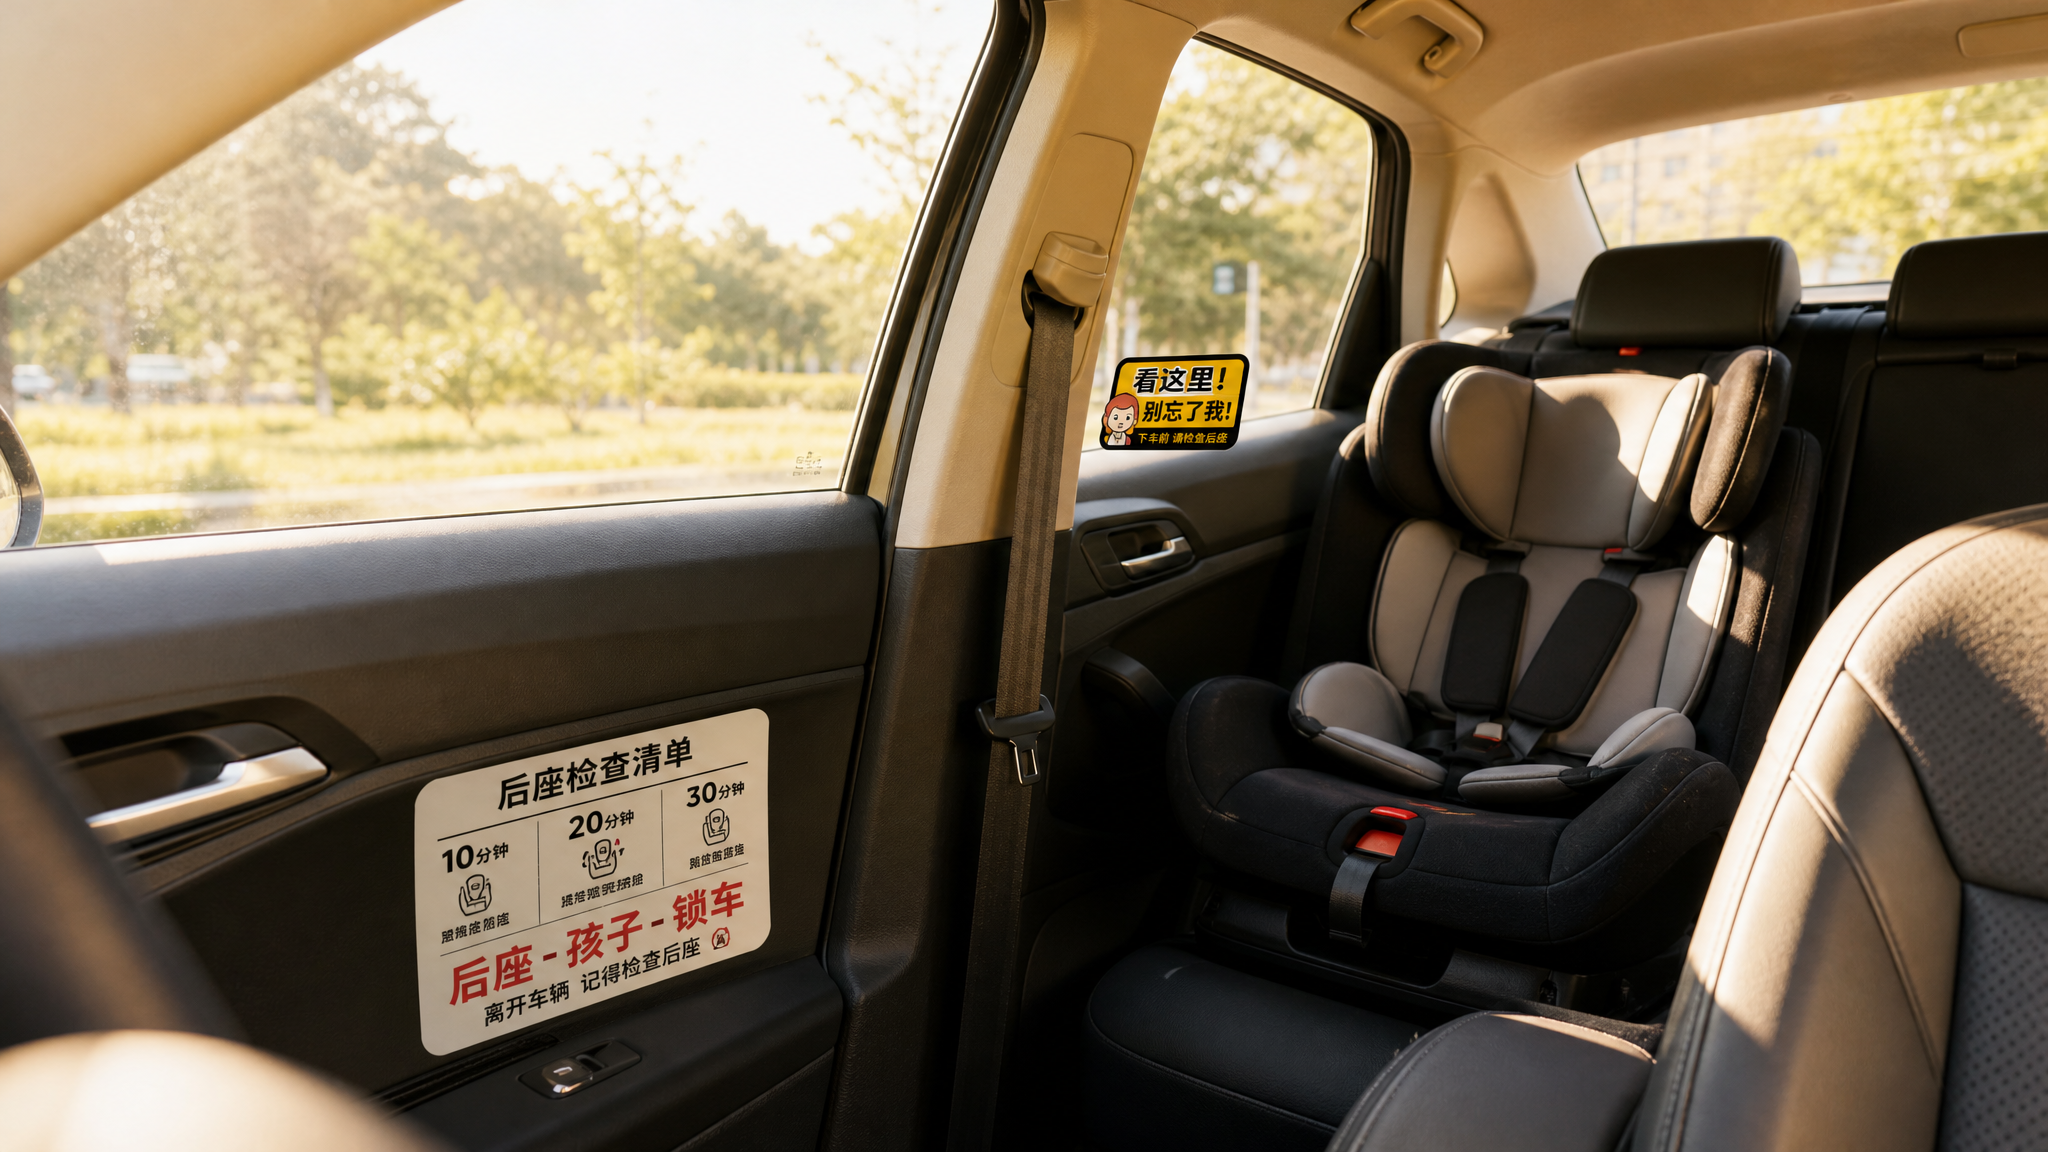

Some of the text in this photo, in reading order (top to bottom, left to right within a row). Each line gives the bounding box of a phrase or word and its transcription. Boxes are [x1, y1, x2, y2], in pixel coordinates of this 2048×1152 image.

[498, 736, 693, 810] 后座检查清单
[686, 781, 745, 808] 30分钟
[568, 809, 635, 840] 20分钟
[441, 842, 509, 873] 10分钟
[484, 937, 701, 1027] 离开车辆 记得检查后座
